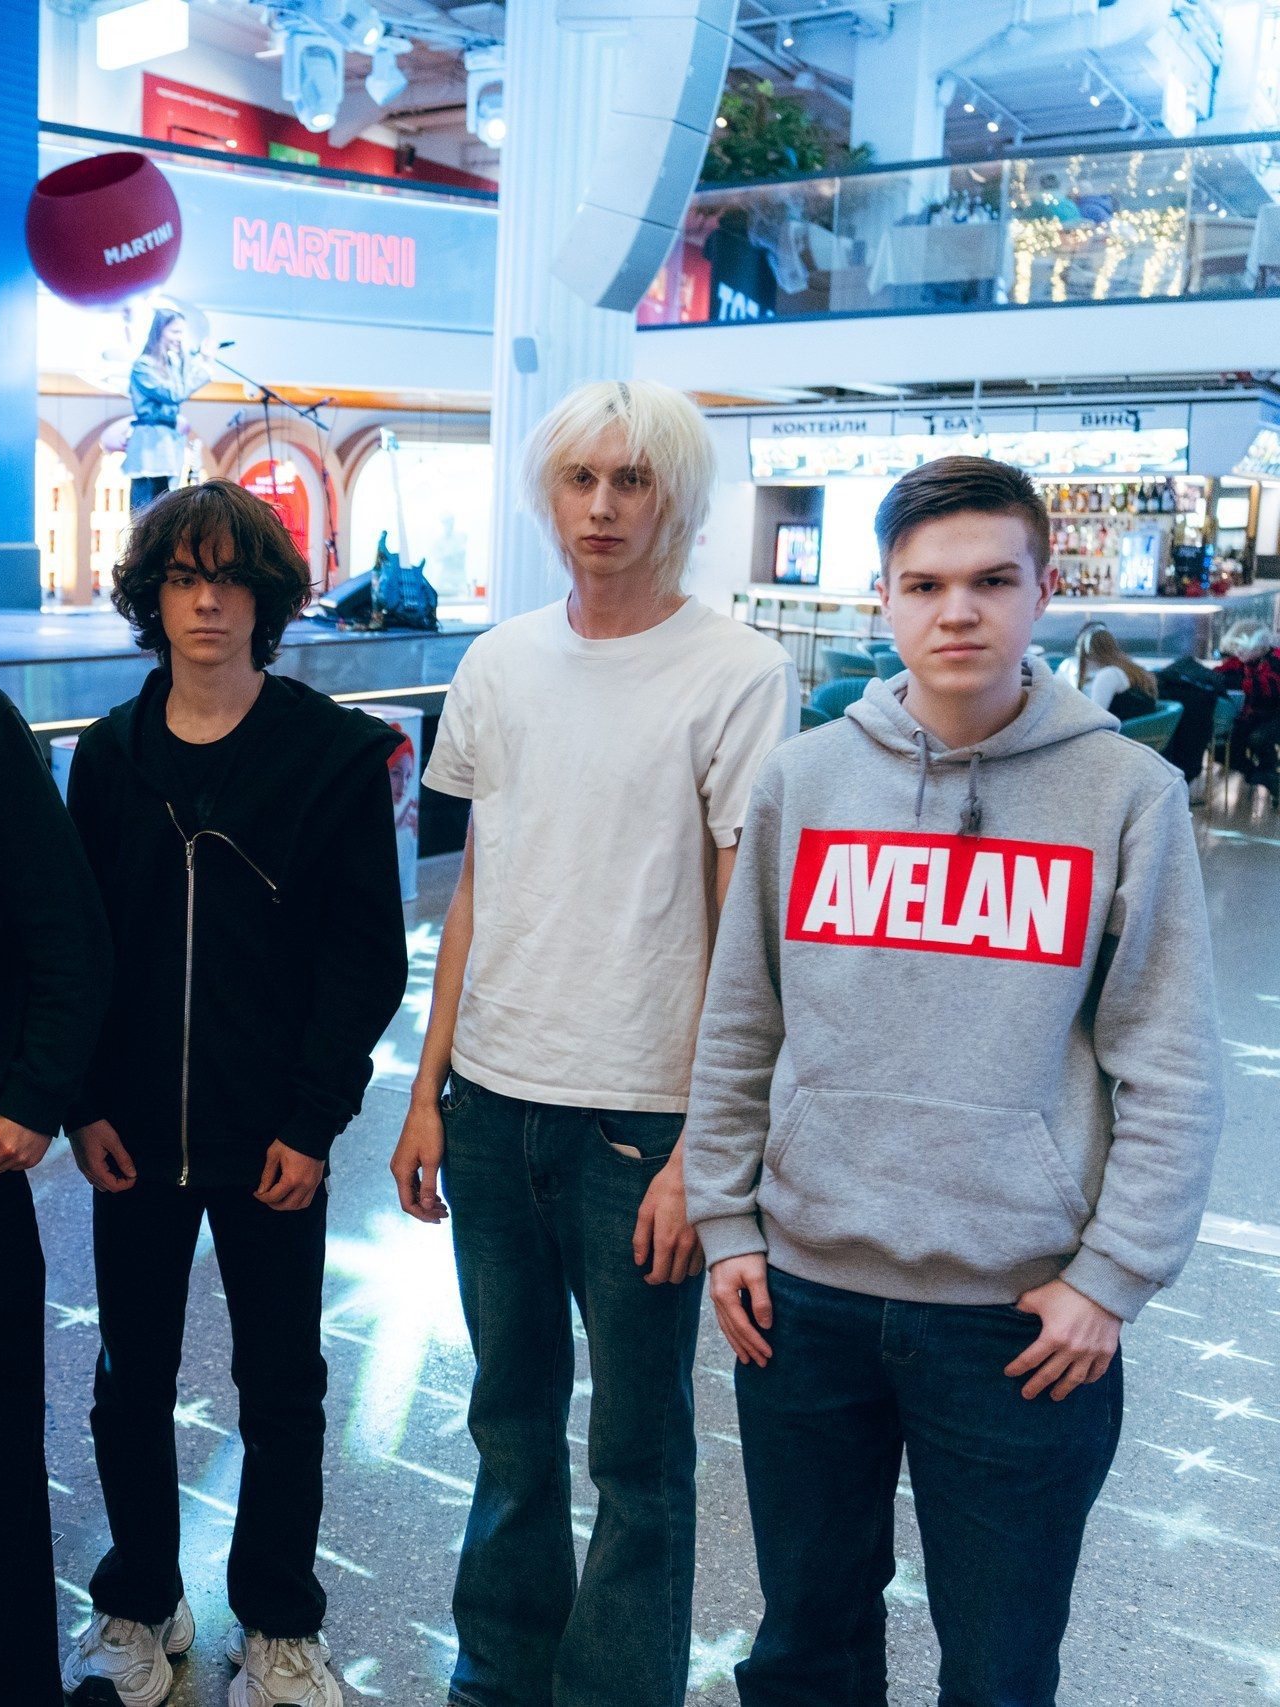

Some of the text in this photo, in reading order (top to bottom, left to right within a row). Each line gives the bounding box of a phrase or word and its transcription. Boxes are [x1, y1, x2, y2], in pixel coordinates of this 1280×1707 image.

[103, 222, 174, 266] MARTINI
[233, 216, 416, 288] MARTINI
[772, 416, 868, 434] КОКТЕЙЛИ
[801, 844, 1072, 955] AVELAN
